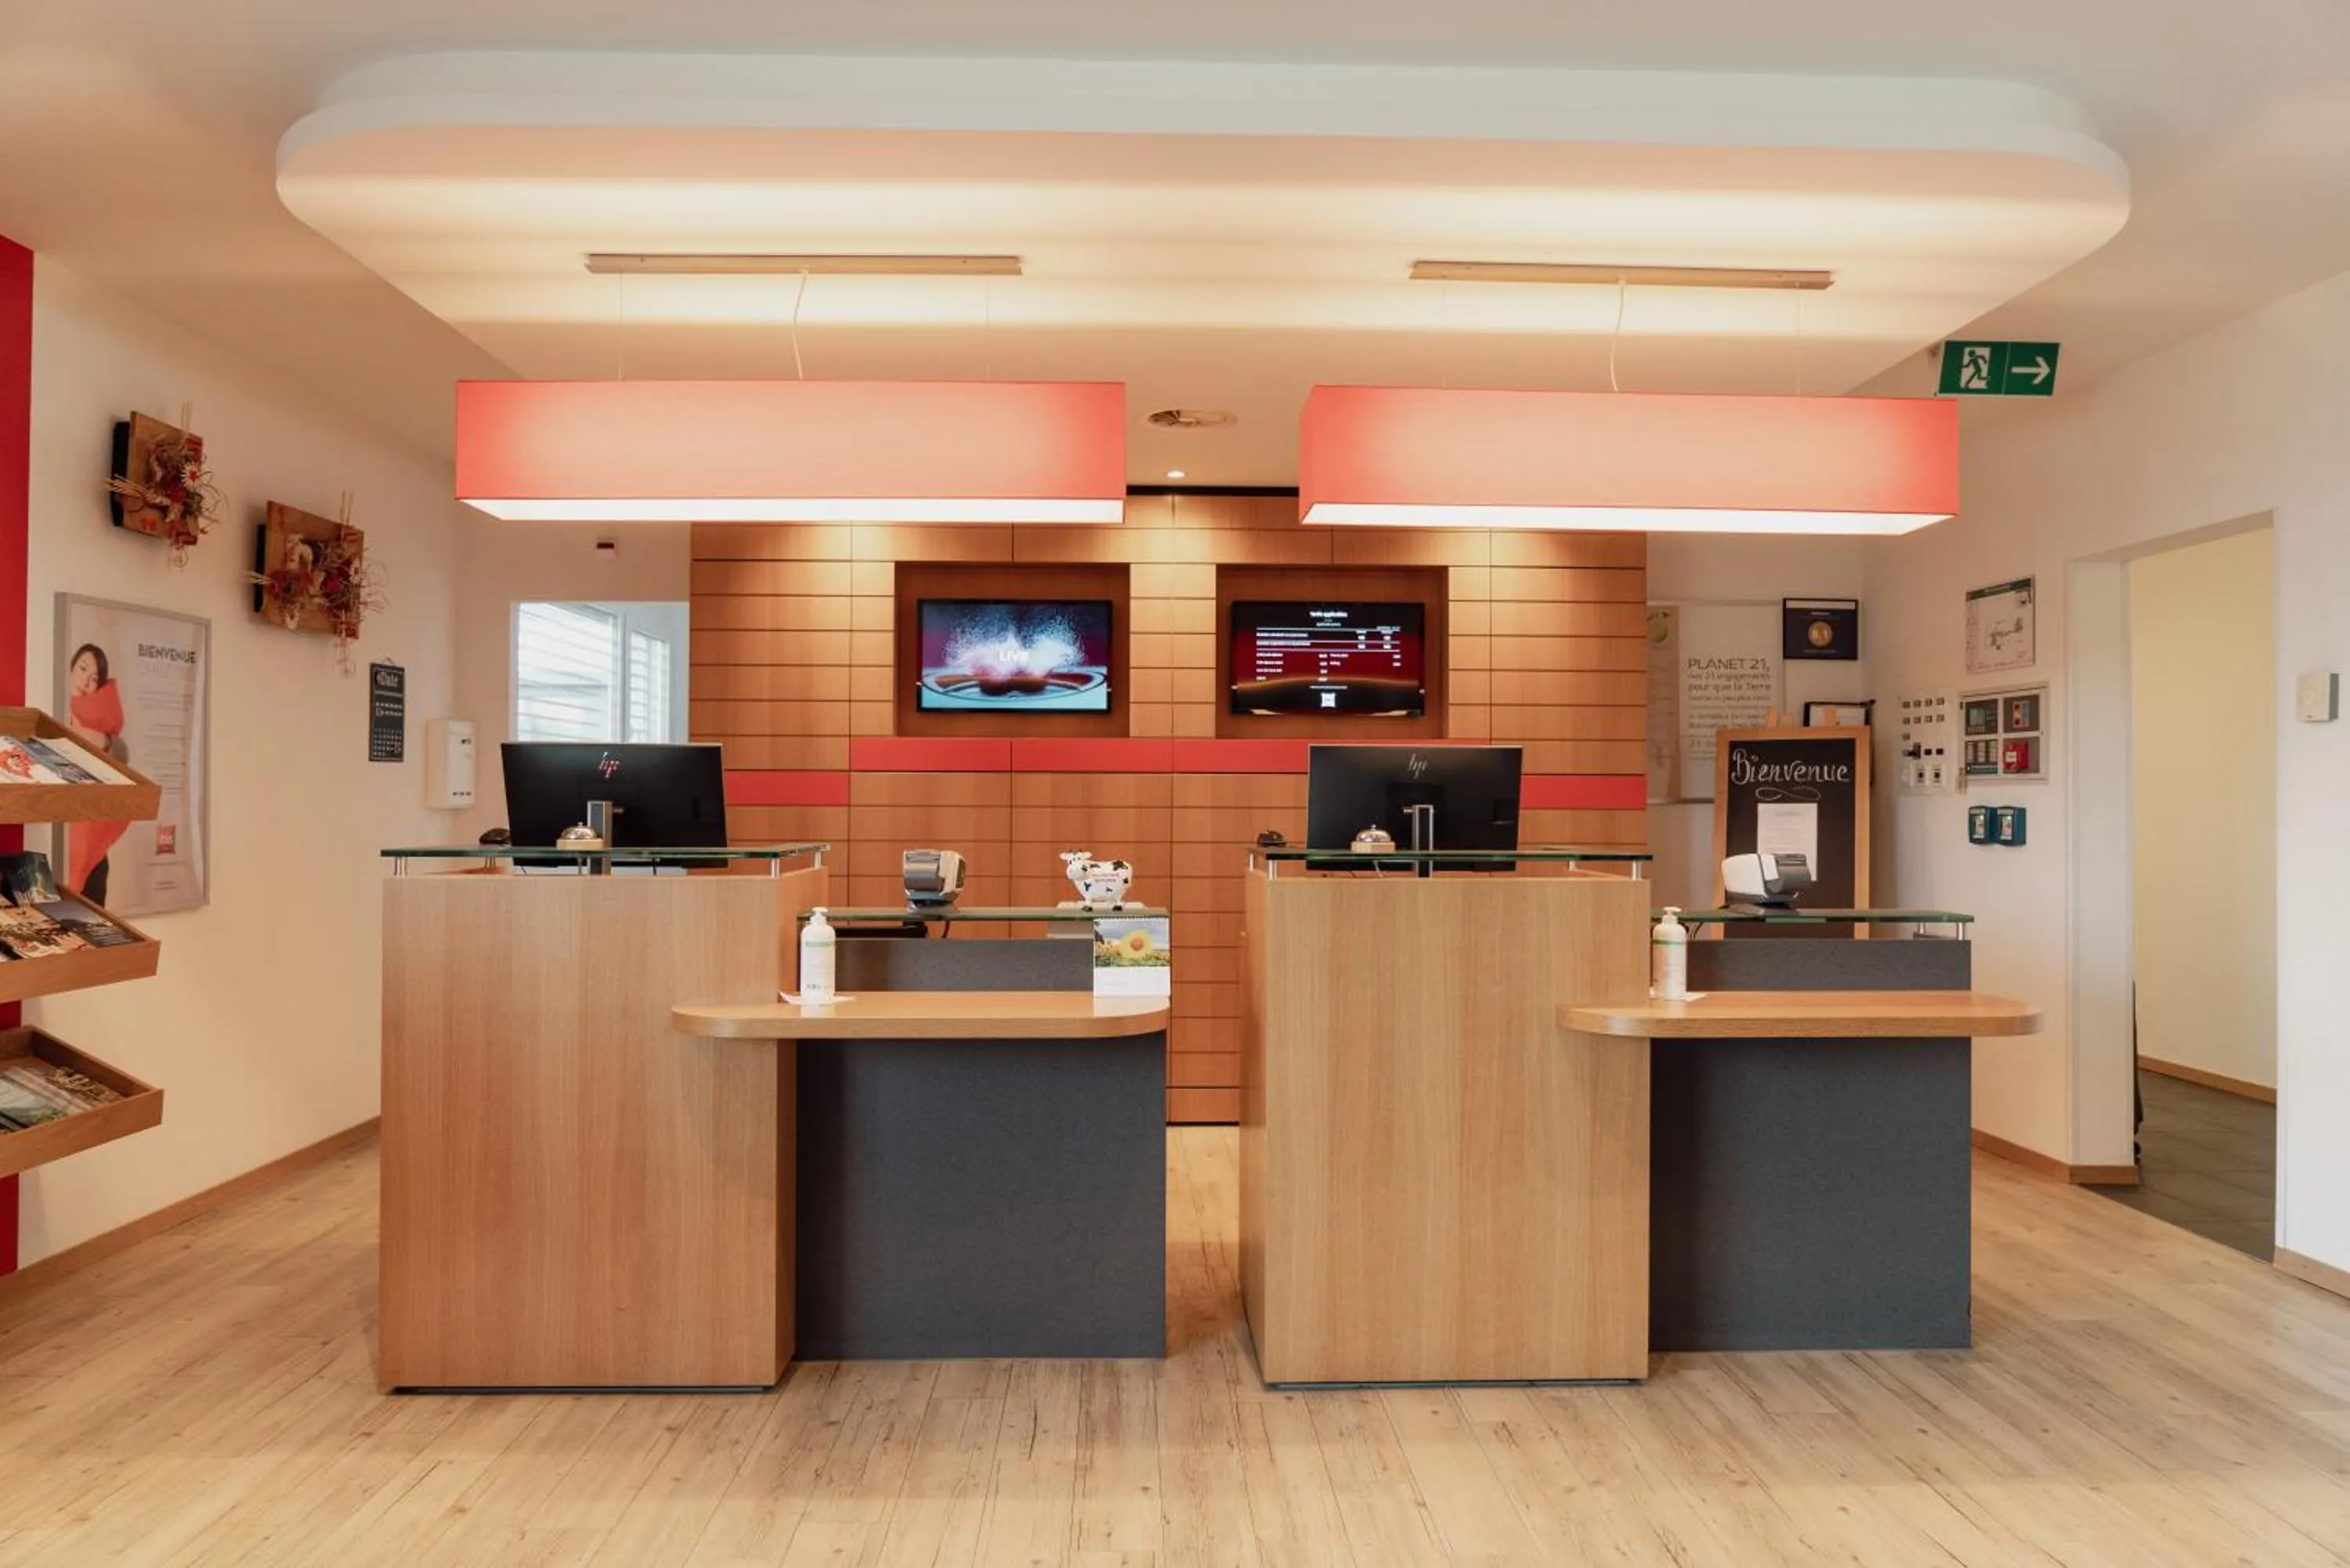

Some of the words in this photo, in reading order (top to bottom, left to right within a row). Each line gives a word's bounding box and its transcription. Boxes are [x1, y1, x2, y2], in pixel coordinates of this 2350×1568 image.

[139, 643, 196, 664] BIENVENUE
[1687, 658, 1744, 670] PLANET
[1749, 658, 1770, 671] 21,
[1746, 682, 1771, 691] Terre
[598, 751, 620, 778] hp
[1408, 752, 1428, 779] hp
[1730, 748, 1849, 785] Bienvenue
